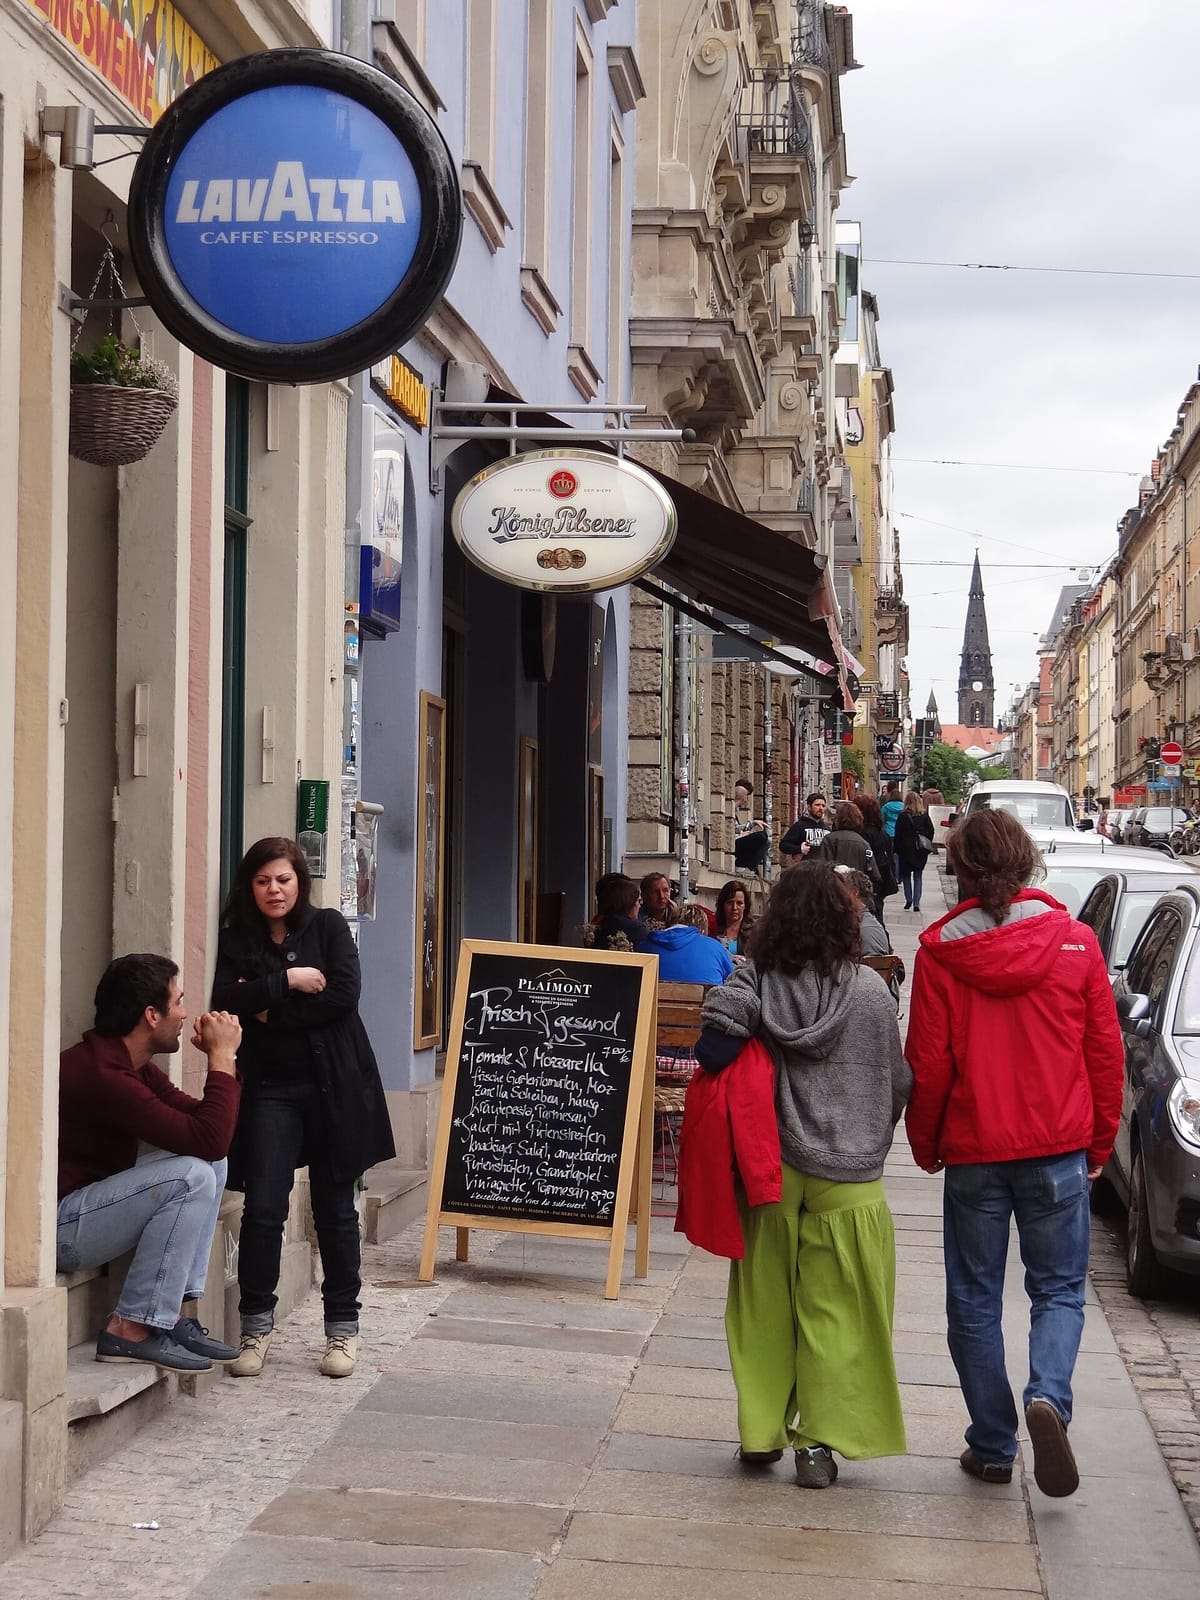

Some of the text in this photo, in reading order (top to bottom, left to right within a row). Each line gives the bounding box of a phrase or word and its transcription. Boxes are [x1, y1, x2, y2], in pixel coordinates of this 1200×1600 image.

[176, 161, 406, 223] LAVAZZA
[272, 231, 379, 245] ESPRESSO
[488, 505, 636, 538] König Pilsener
[305, 785, 318, 829] Chartreuse
[518, 978, 592, 995] PLAIMONT
[554, 1011, 621, 1042] gesund
[465, 1041, 514, 1074] Tomate
[533, 1046, 611, 1077] Mozzarella
[461, 1113, 501, 1144] Salat
[502, 1121, 522, 1137] mit
[532, 1178, 589, 1201] Parmesan
